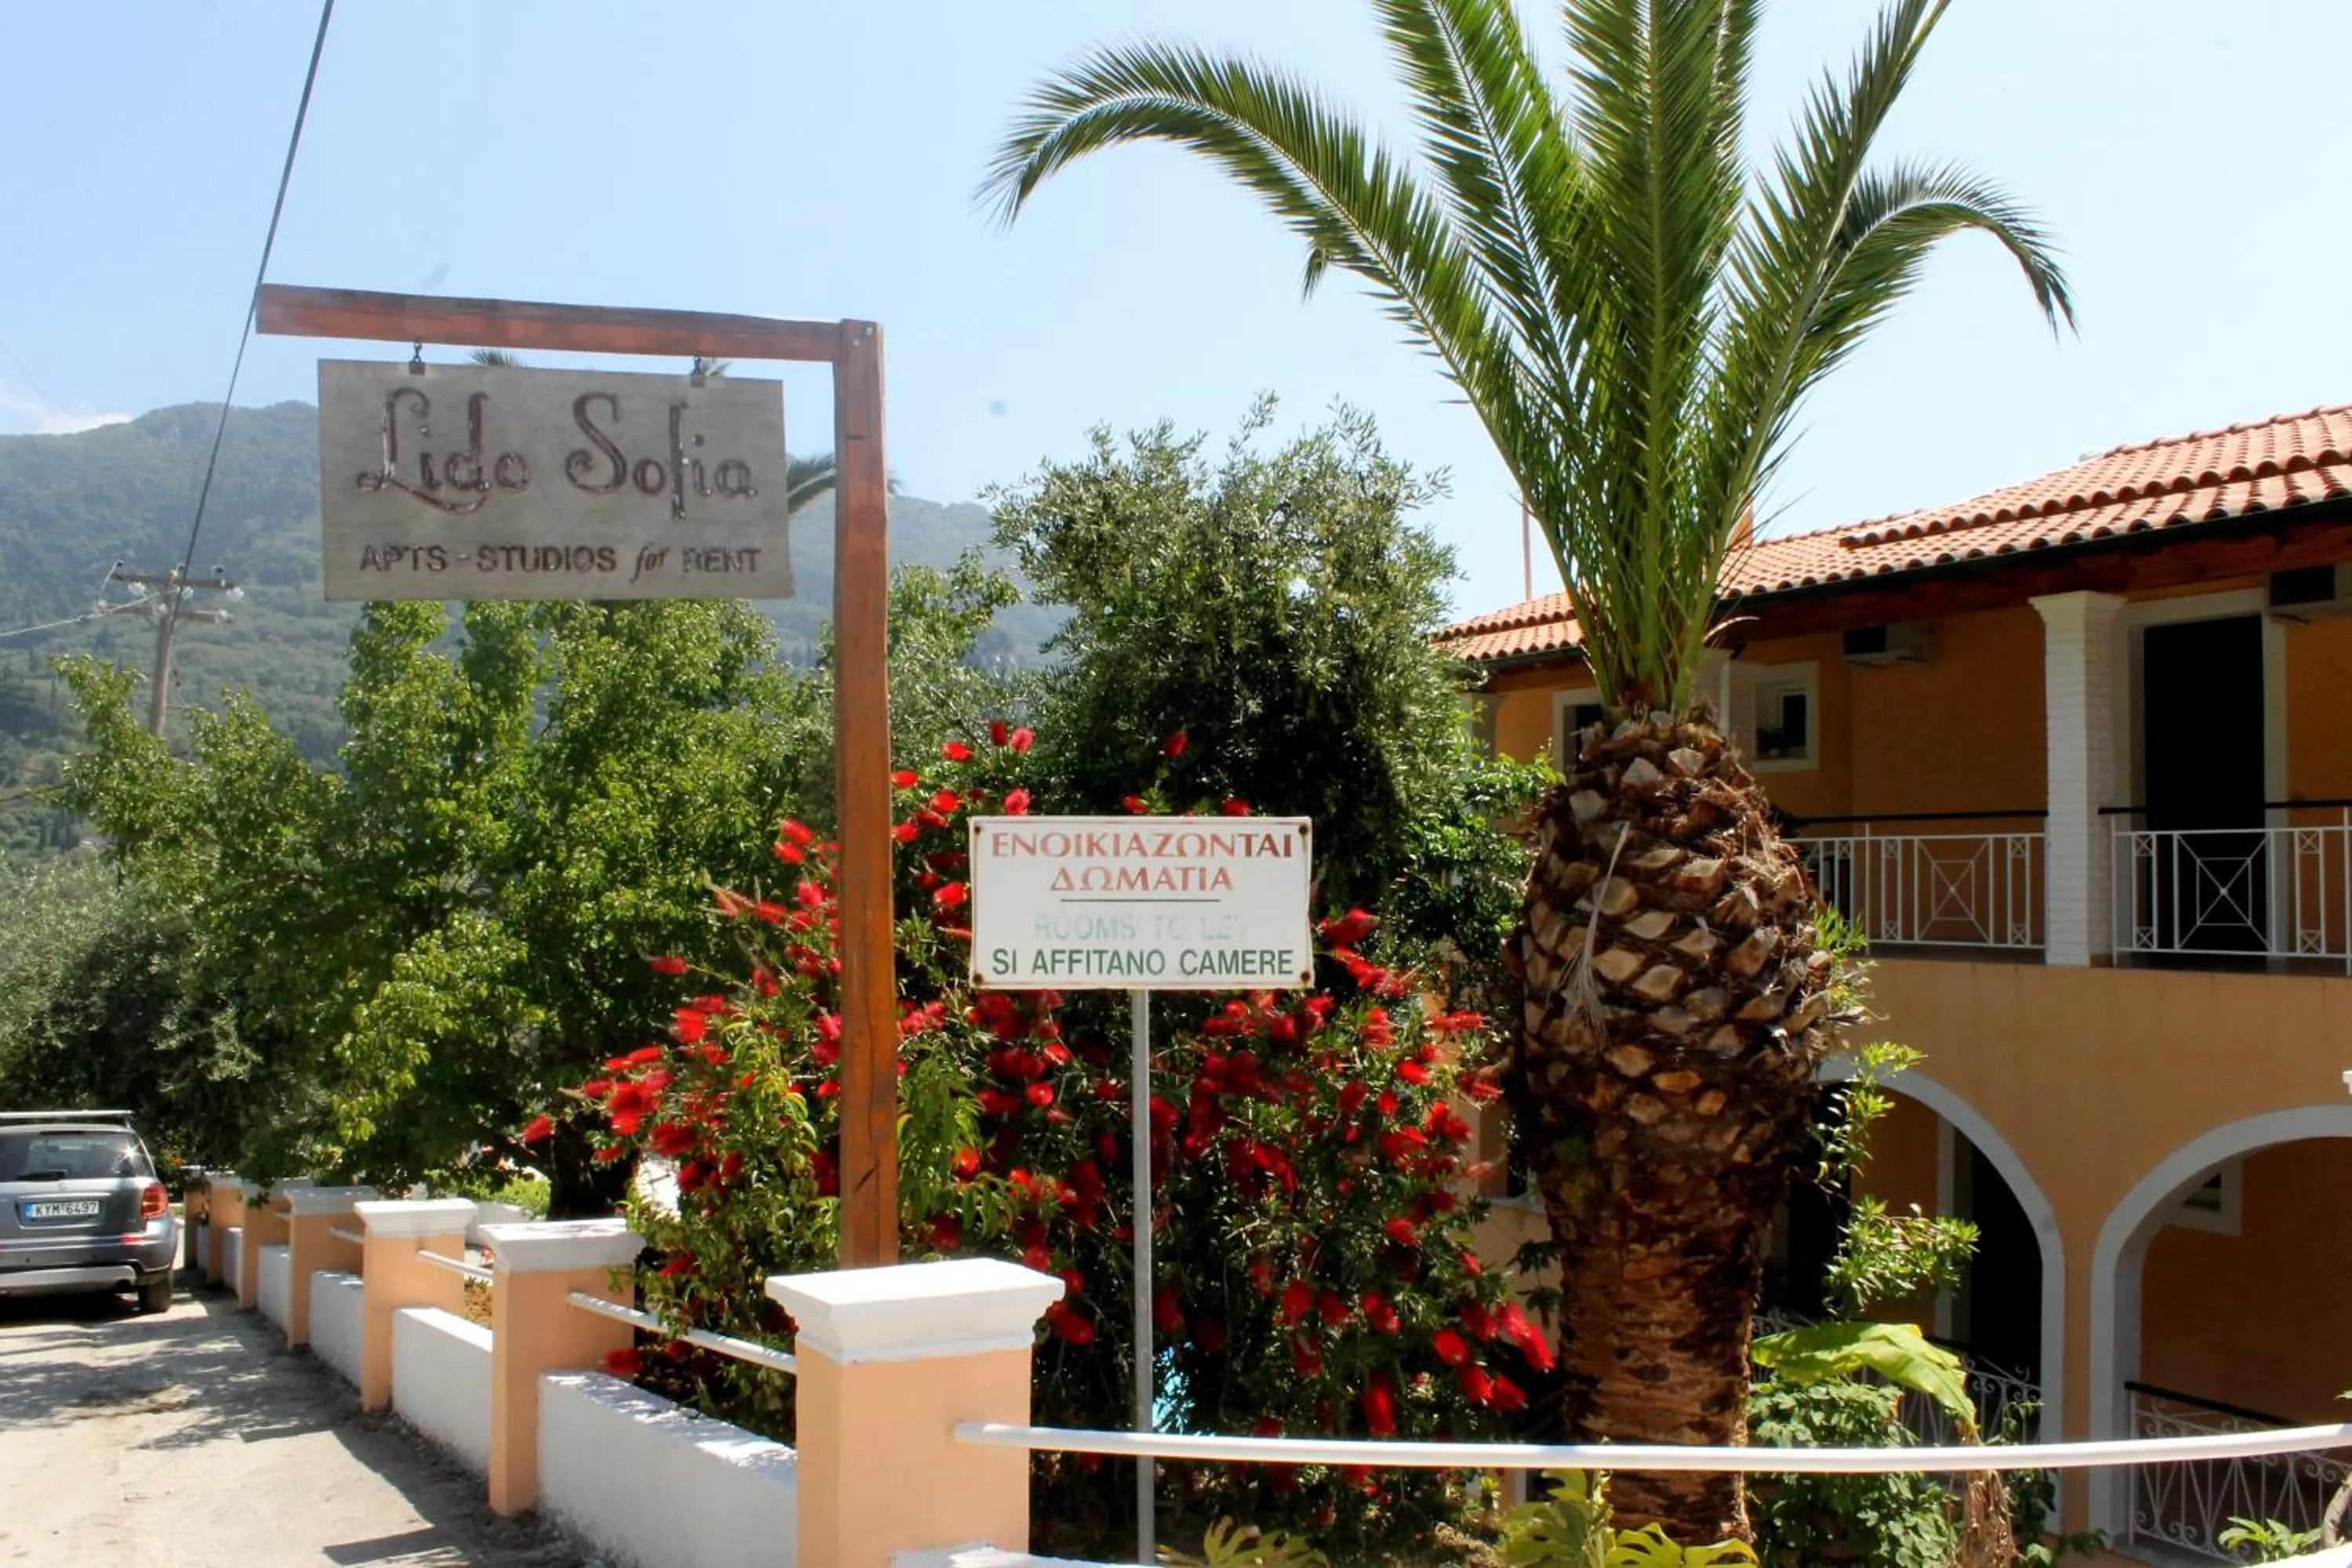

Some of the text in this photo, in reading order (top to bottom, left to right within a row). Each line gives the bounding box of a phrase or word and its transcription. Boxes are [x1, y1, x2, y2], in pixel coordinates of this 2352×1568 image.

[355, 387, 758, 520] Lido Sofia
[360, 545, 448, 573] APTS
[476, 544, 617, 573] STUDIOS
[630, 545, 668, 583] for
[683, 547, 761, 573] RENT
[992, 832, 1292, 858] ΕΝΟΙΚΙΑΖΩΝΤΑΙ
[1050, 866, 1233, 891] ΔΩΜΑΤΙΑ
[1034, 915, 1136, 940] ROOMS
[1154, 915, 1184, 940] TO
[992, 949, 1294, 975] SI AFFITANO CAMERE
